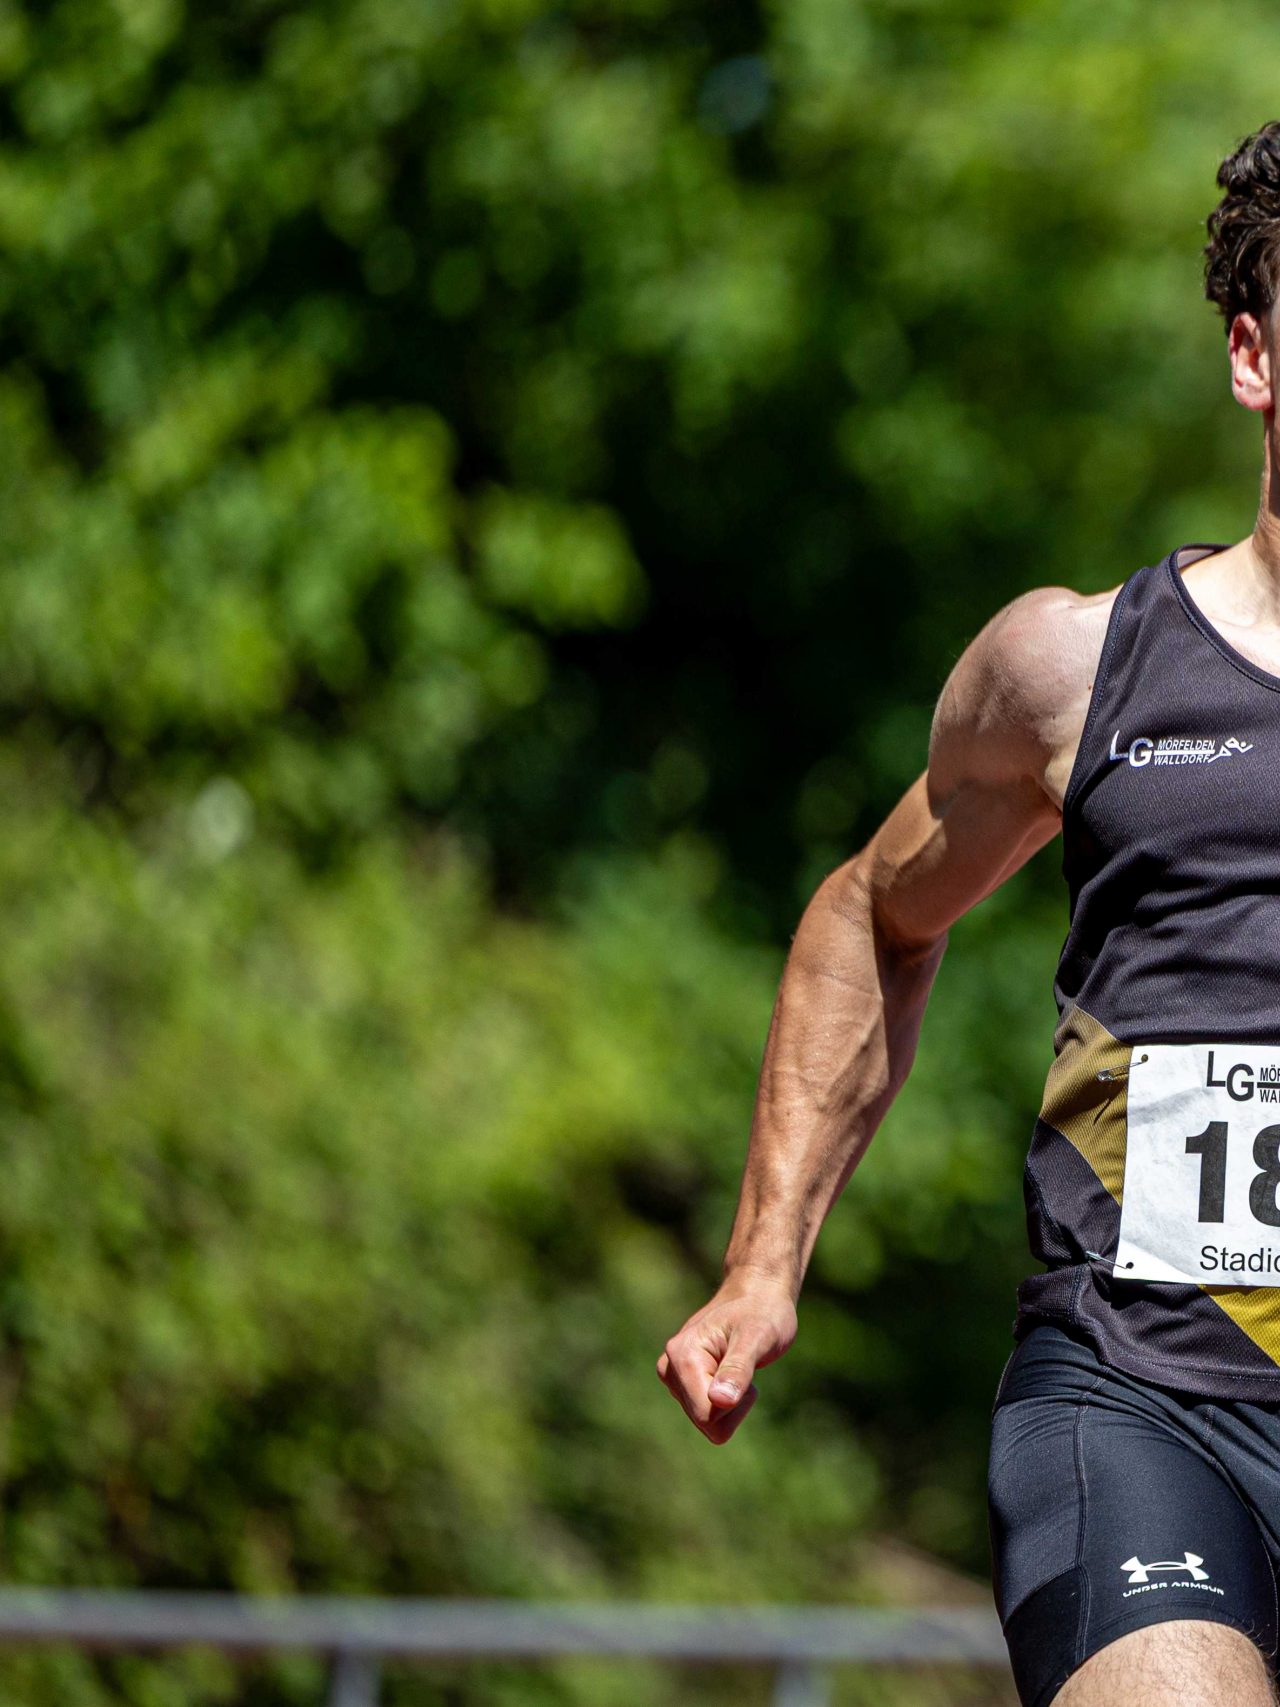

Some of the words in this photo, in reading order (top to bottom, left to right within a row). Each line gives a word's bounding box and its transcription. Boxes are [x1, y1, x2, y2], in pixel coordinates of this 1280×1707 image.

[1109, 730, 1153, 767] LG
[1157, 737, 1215, 750] MÖRFELDEN
[1154, 753, 1210, 766] WALLDORF
[1206, 1050, 1255, 1102] LG
[1122, 1581, 1168, 1598] UNDER
[1171, 1581, 1225, 1596] ARMOUR
